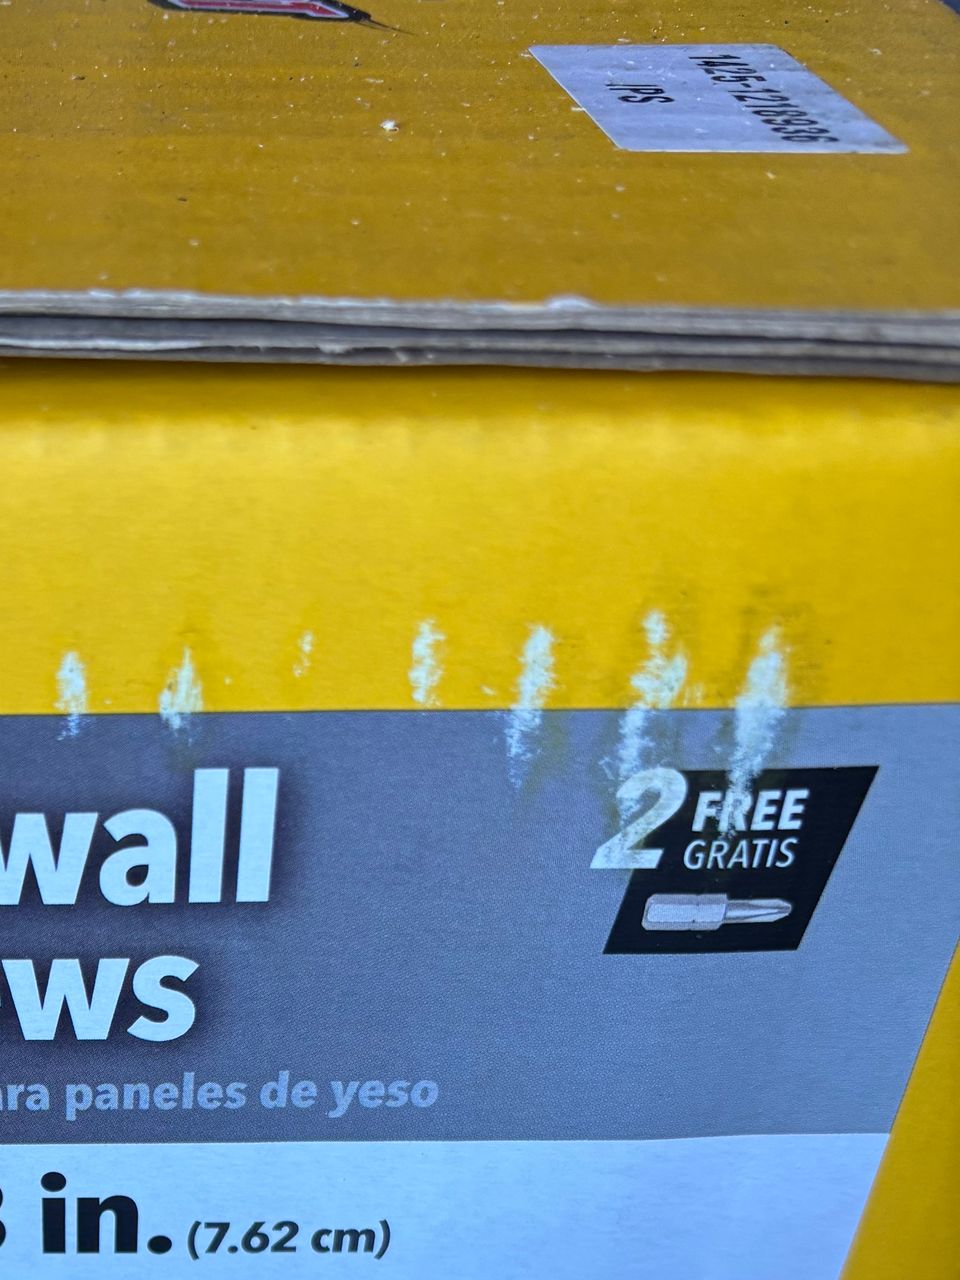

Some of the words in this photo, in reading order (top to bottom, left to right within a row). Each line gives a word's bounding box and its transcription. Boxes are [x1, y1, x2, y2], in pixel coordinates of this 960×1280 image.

[605, 83, 675, 105] IPS
[688, 54, 839, 143] 1425-1218936
[590, 767, 688, 869] 2
[691, 788, 810, 832] FREE
[683, 837, 798, 870] GRATIS
[65, 1072, 248, 1122] paneles
[259, 1071, 317, 1109] de
[328, 1080, 440, 1118] yeso
[40, 1171, 173, 1255] in.
[187, 1219, 299, 1260] (7.62
[311, 1219, 391, 1260] cm)
